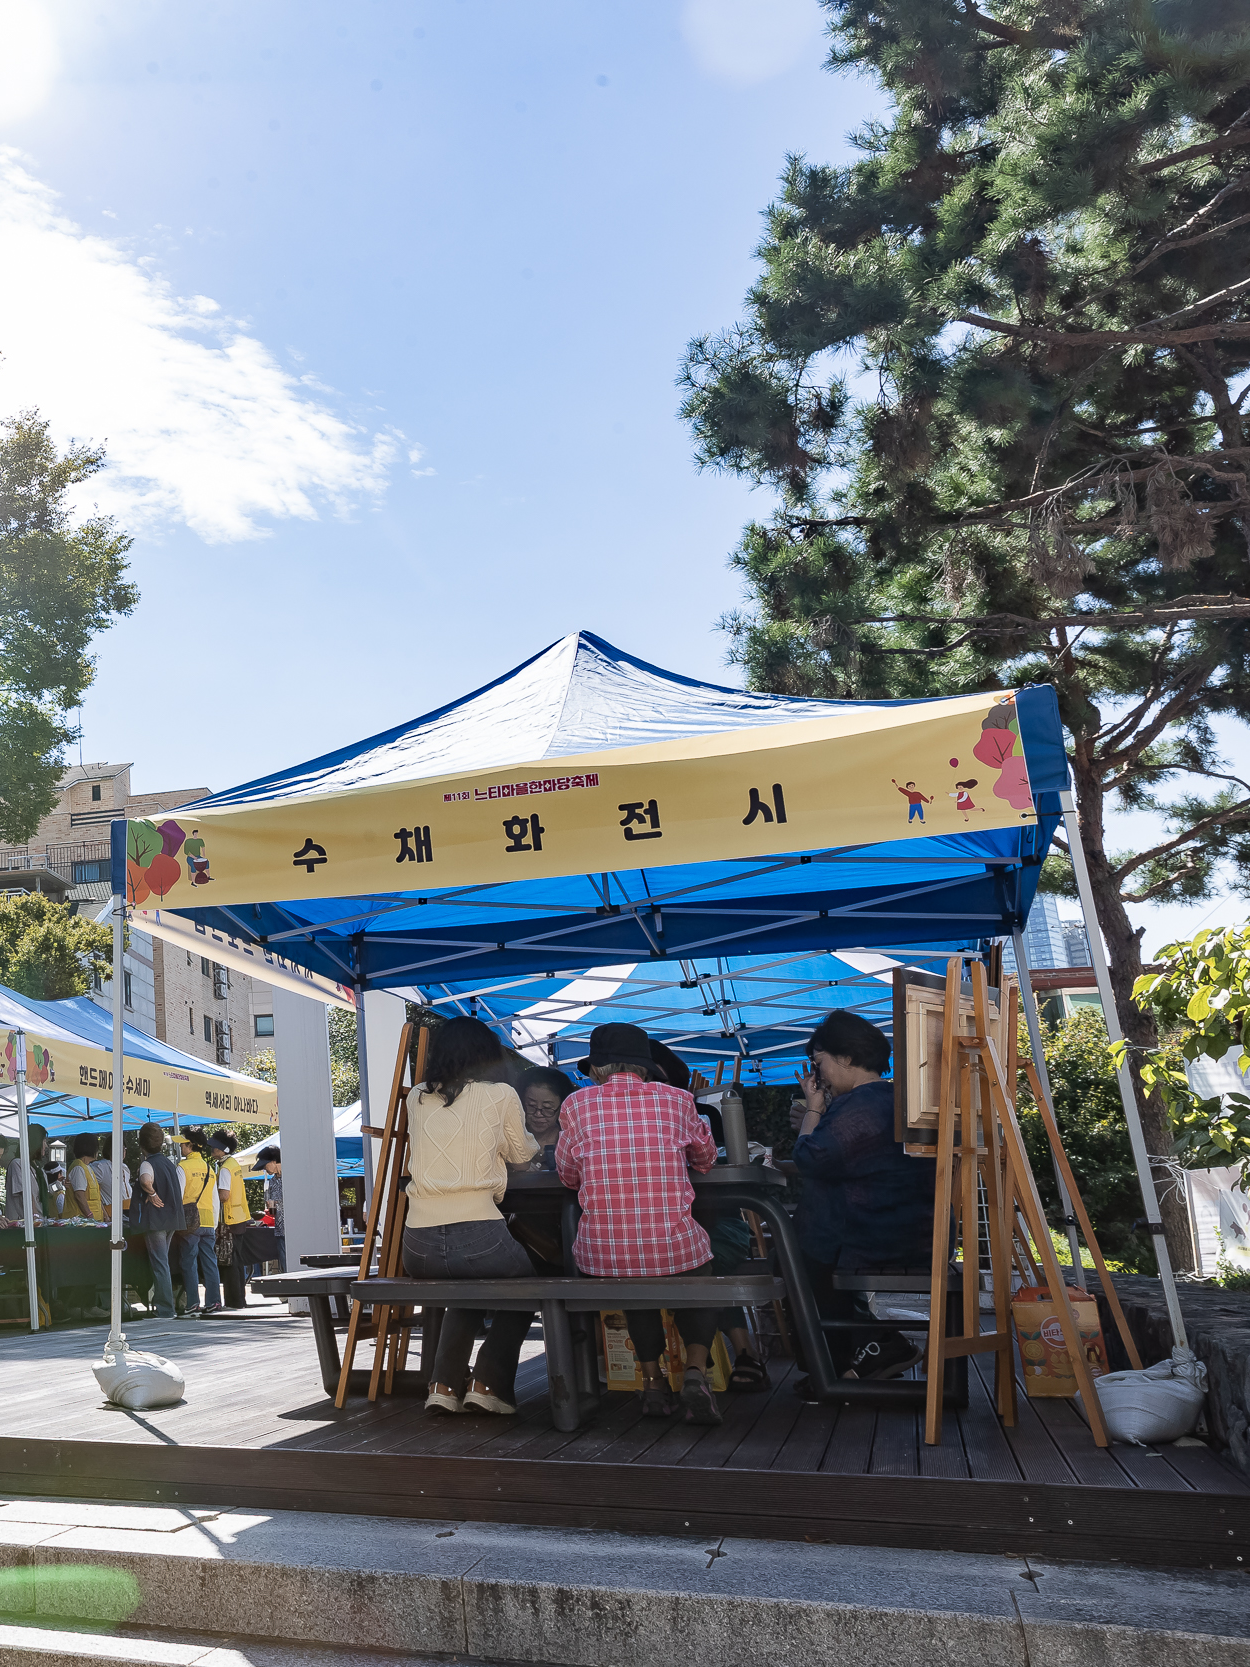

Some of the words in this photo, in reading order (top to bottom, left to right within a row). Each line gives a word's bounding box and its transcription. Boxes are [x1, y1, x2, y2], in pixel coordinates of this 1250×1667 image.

[443, 791, 470, 802] 제11회
[474, 773, 600, 801] 느티마을한마당축제
[205, 1091, 231, 1111] 액세서리
[233, 1095, 259, 1115] 아나바다
